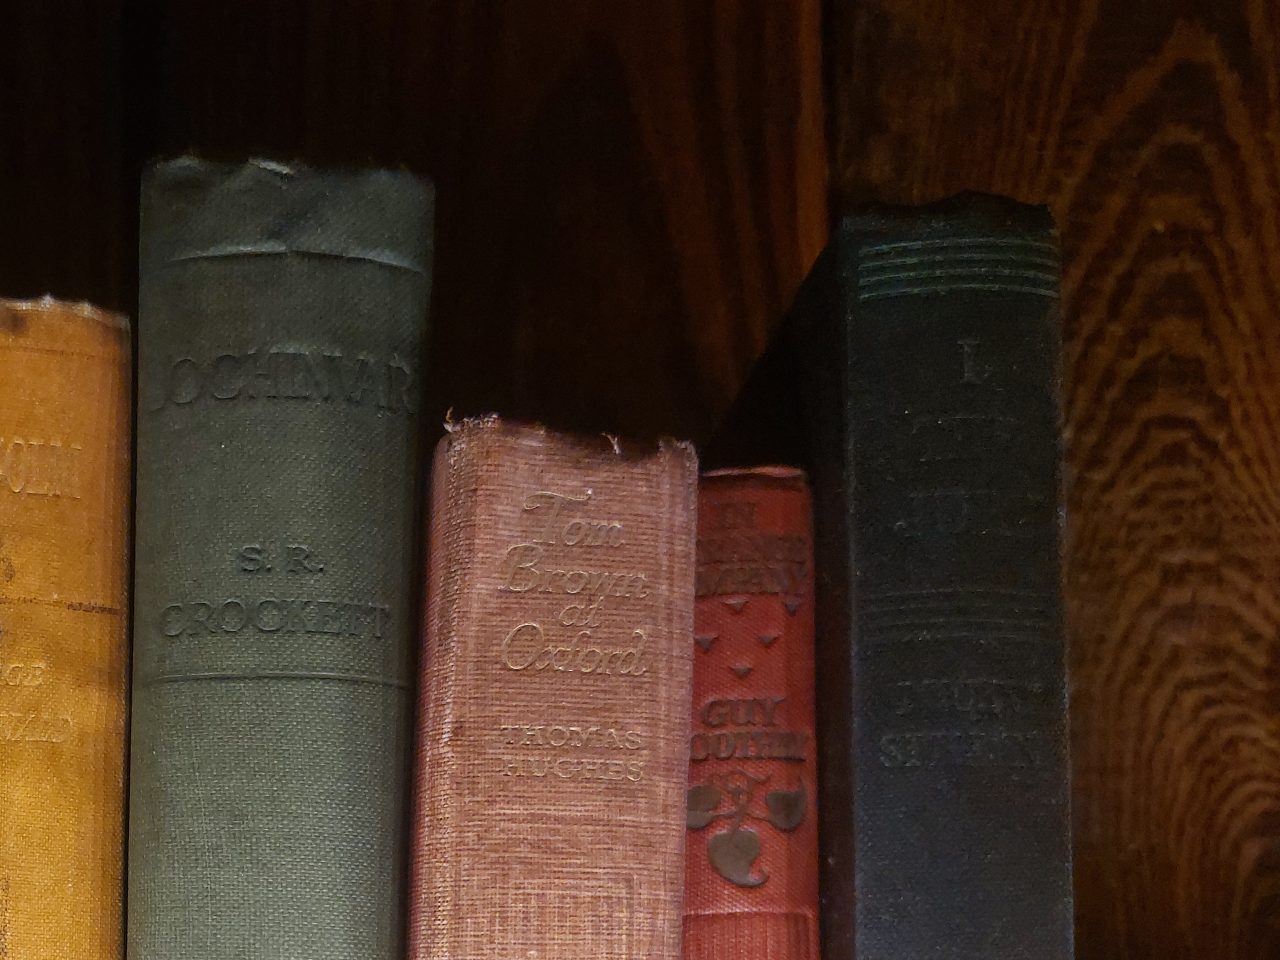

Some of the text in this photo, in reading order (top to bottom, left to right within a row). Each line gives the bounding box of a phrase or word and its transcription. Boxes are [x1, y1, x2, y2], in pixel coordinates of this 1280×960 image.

[524, 489, 624, 547] Tom
[236, 545, 324, 574] S. R.
[498, 544, 649, 599] Brown
[162, 599, 389, 638] CROCKETT
[559, 596, 603, 628] at
[501, 623, 651, 676] Oxford
[501, 724, 643, 750] THOMAS
[501, 755, 644, 782] HUGHES
